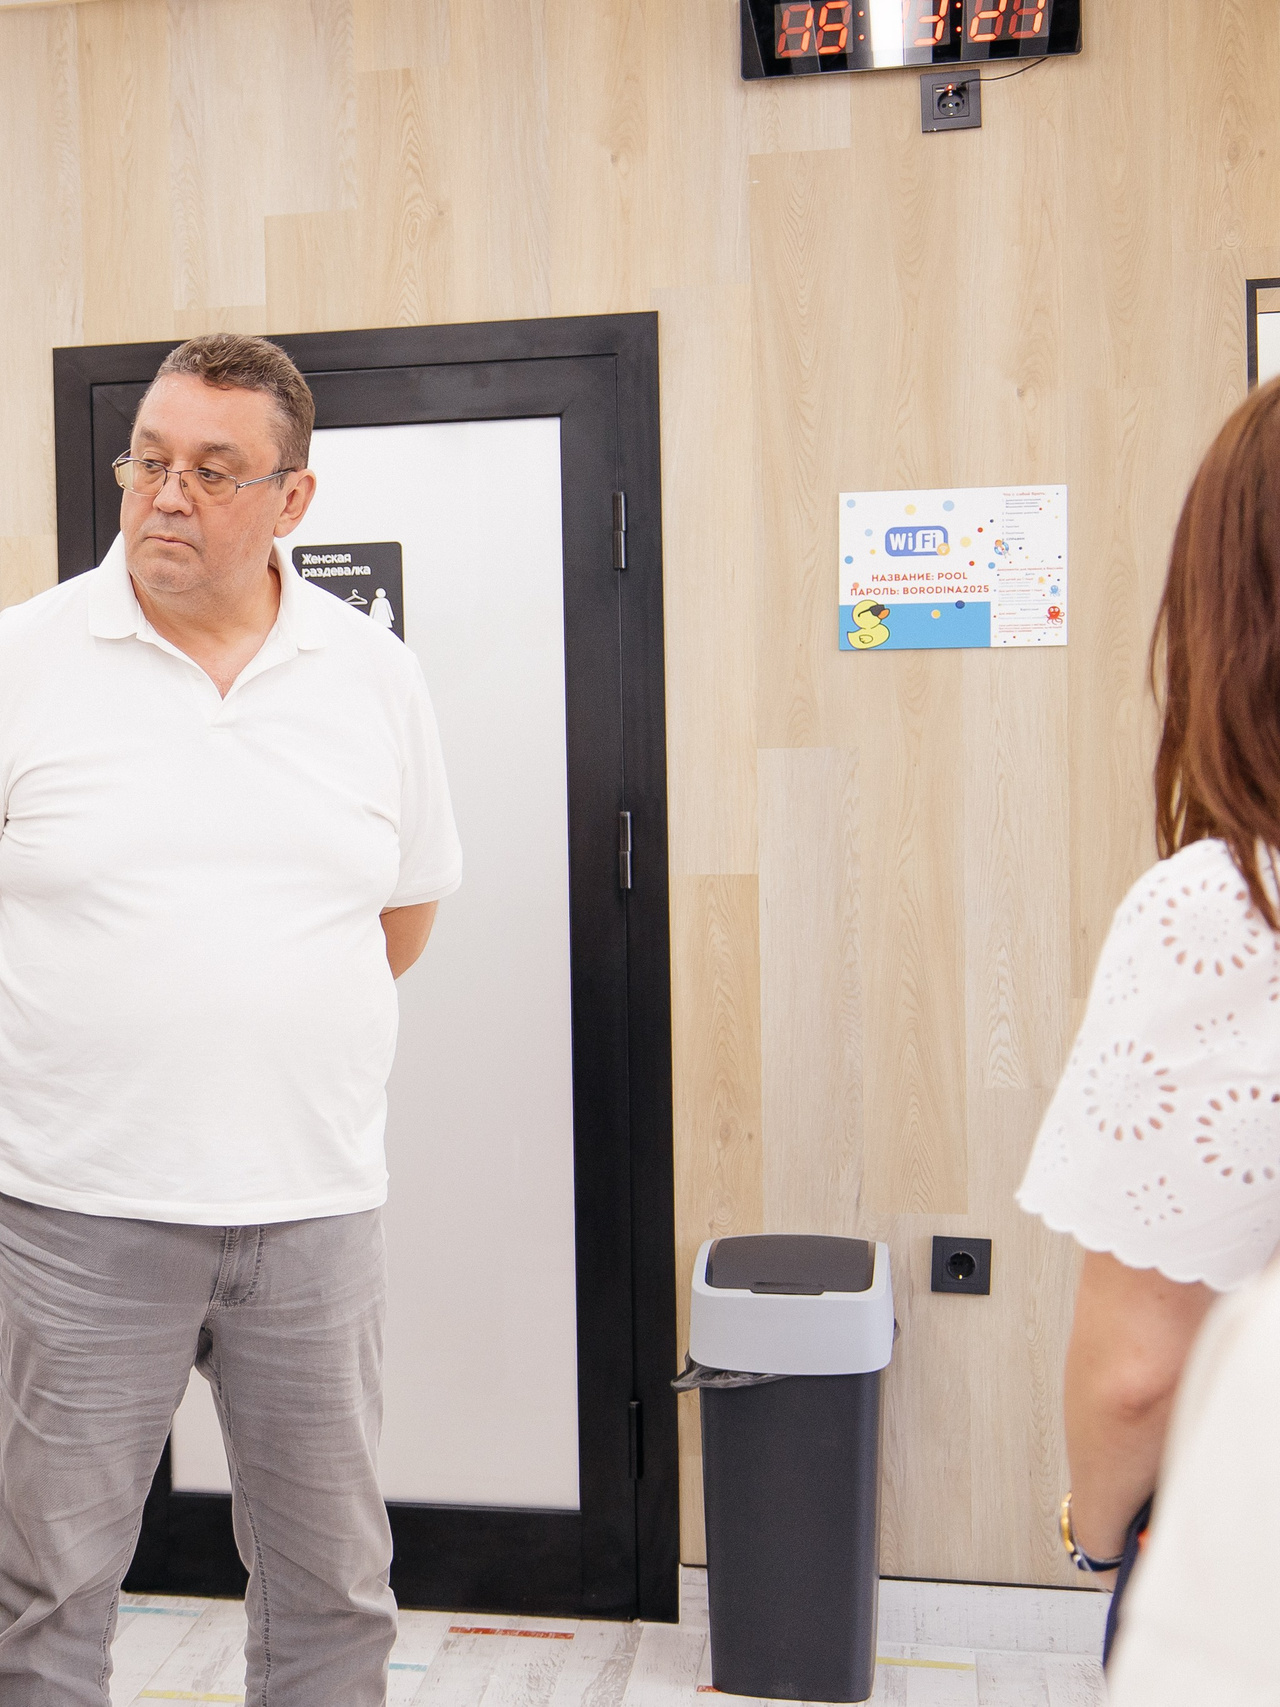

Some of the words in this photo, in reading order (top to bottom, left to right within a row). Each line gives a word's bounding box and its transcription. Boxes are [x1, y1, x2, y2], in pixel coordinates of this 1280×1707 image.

[302, 552, 352, 565] Женская
[301, 564, 371, 579] раздевалка
[872, 572, 934, 582] НАЗВАНИЕ:
[937, 571, 968, 580] POOL
[850, 586, 900, 596] ПАРОЛЬ:
[903, 584, 989, 595] BORODINA2025
